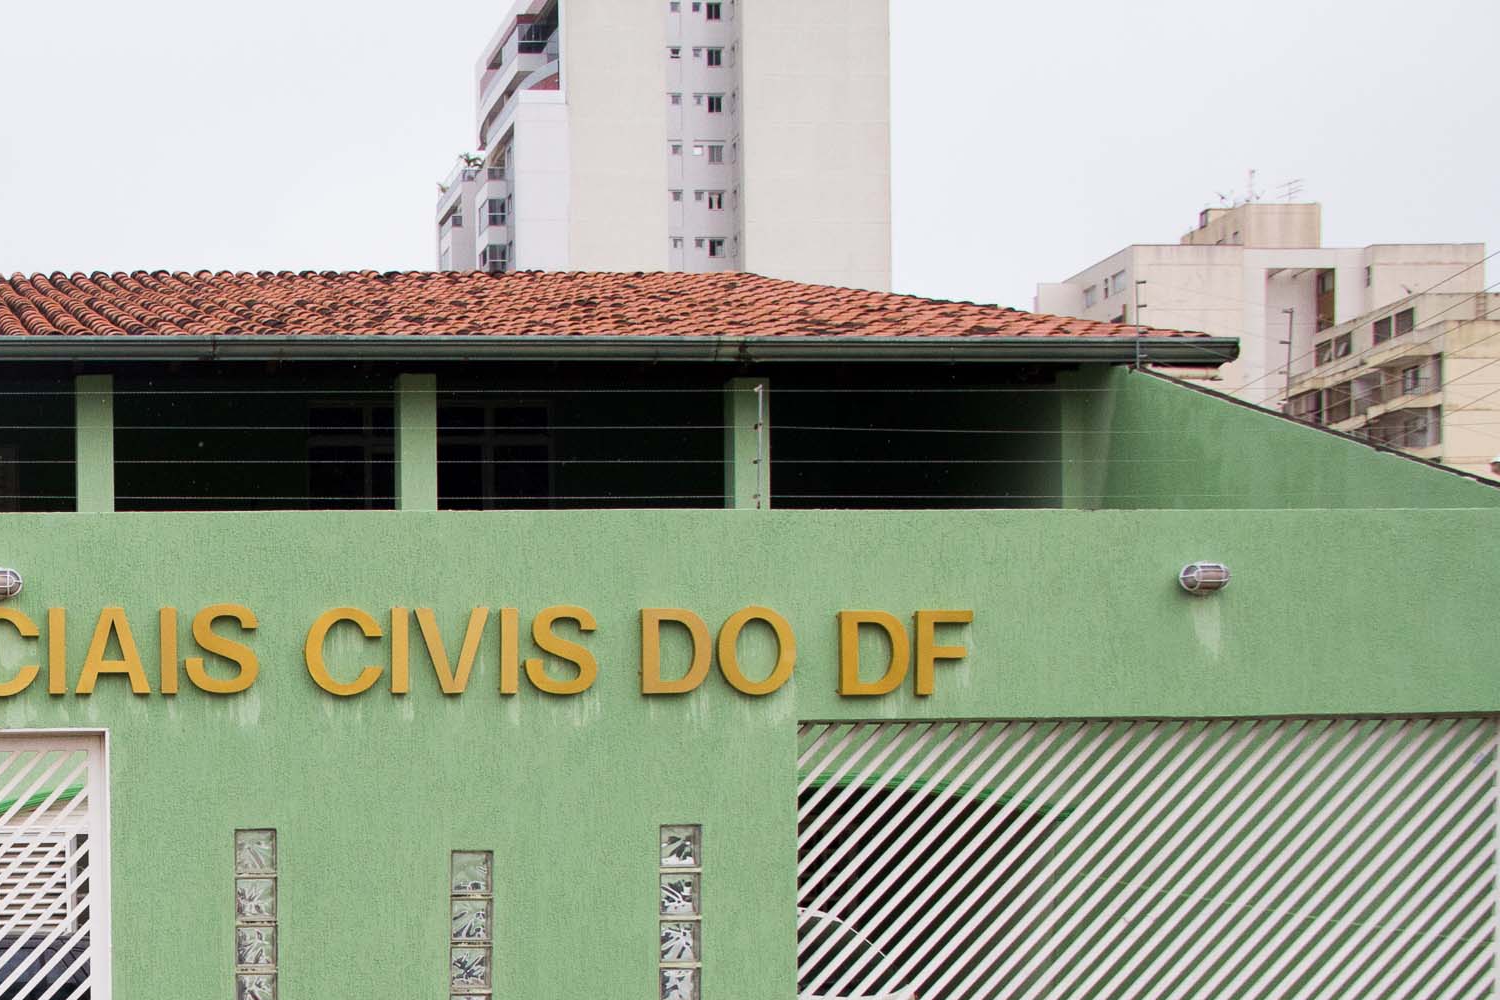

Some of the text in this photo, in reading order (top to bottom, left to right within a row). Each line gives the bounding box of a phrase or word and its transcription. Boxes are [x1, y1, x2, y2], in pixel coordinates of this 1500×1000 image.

[303, 605, 598, 696] CIVIS
[639, 606, 797, 696] DO
[837, 610, 974, 697] DF
